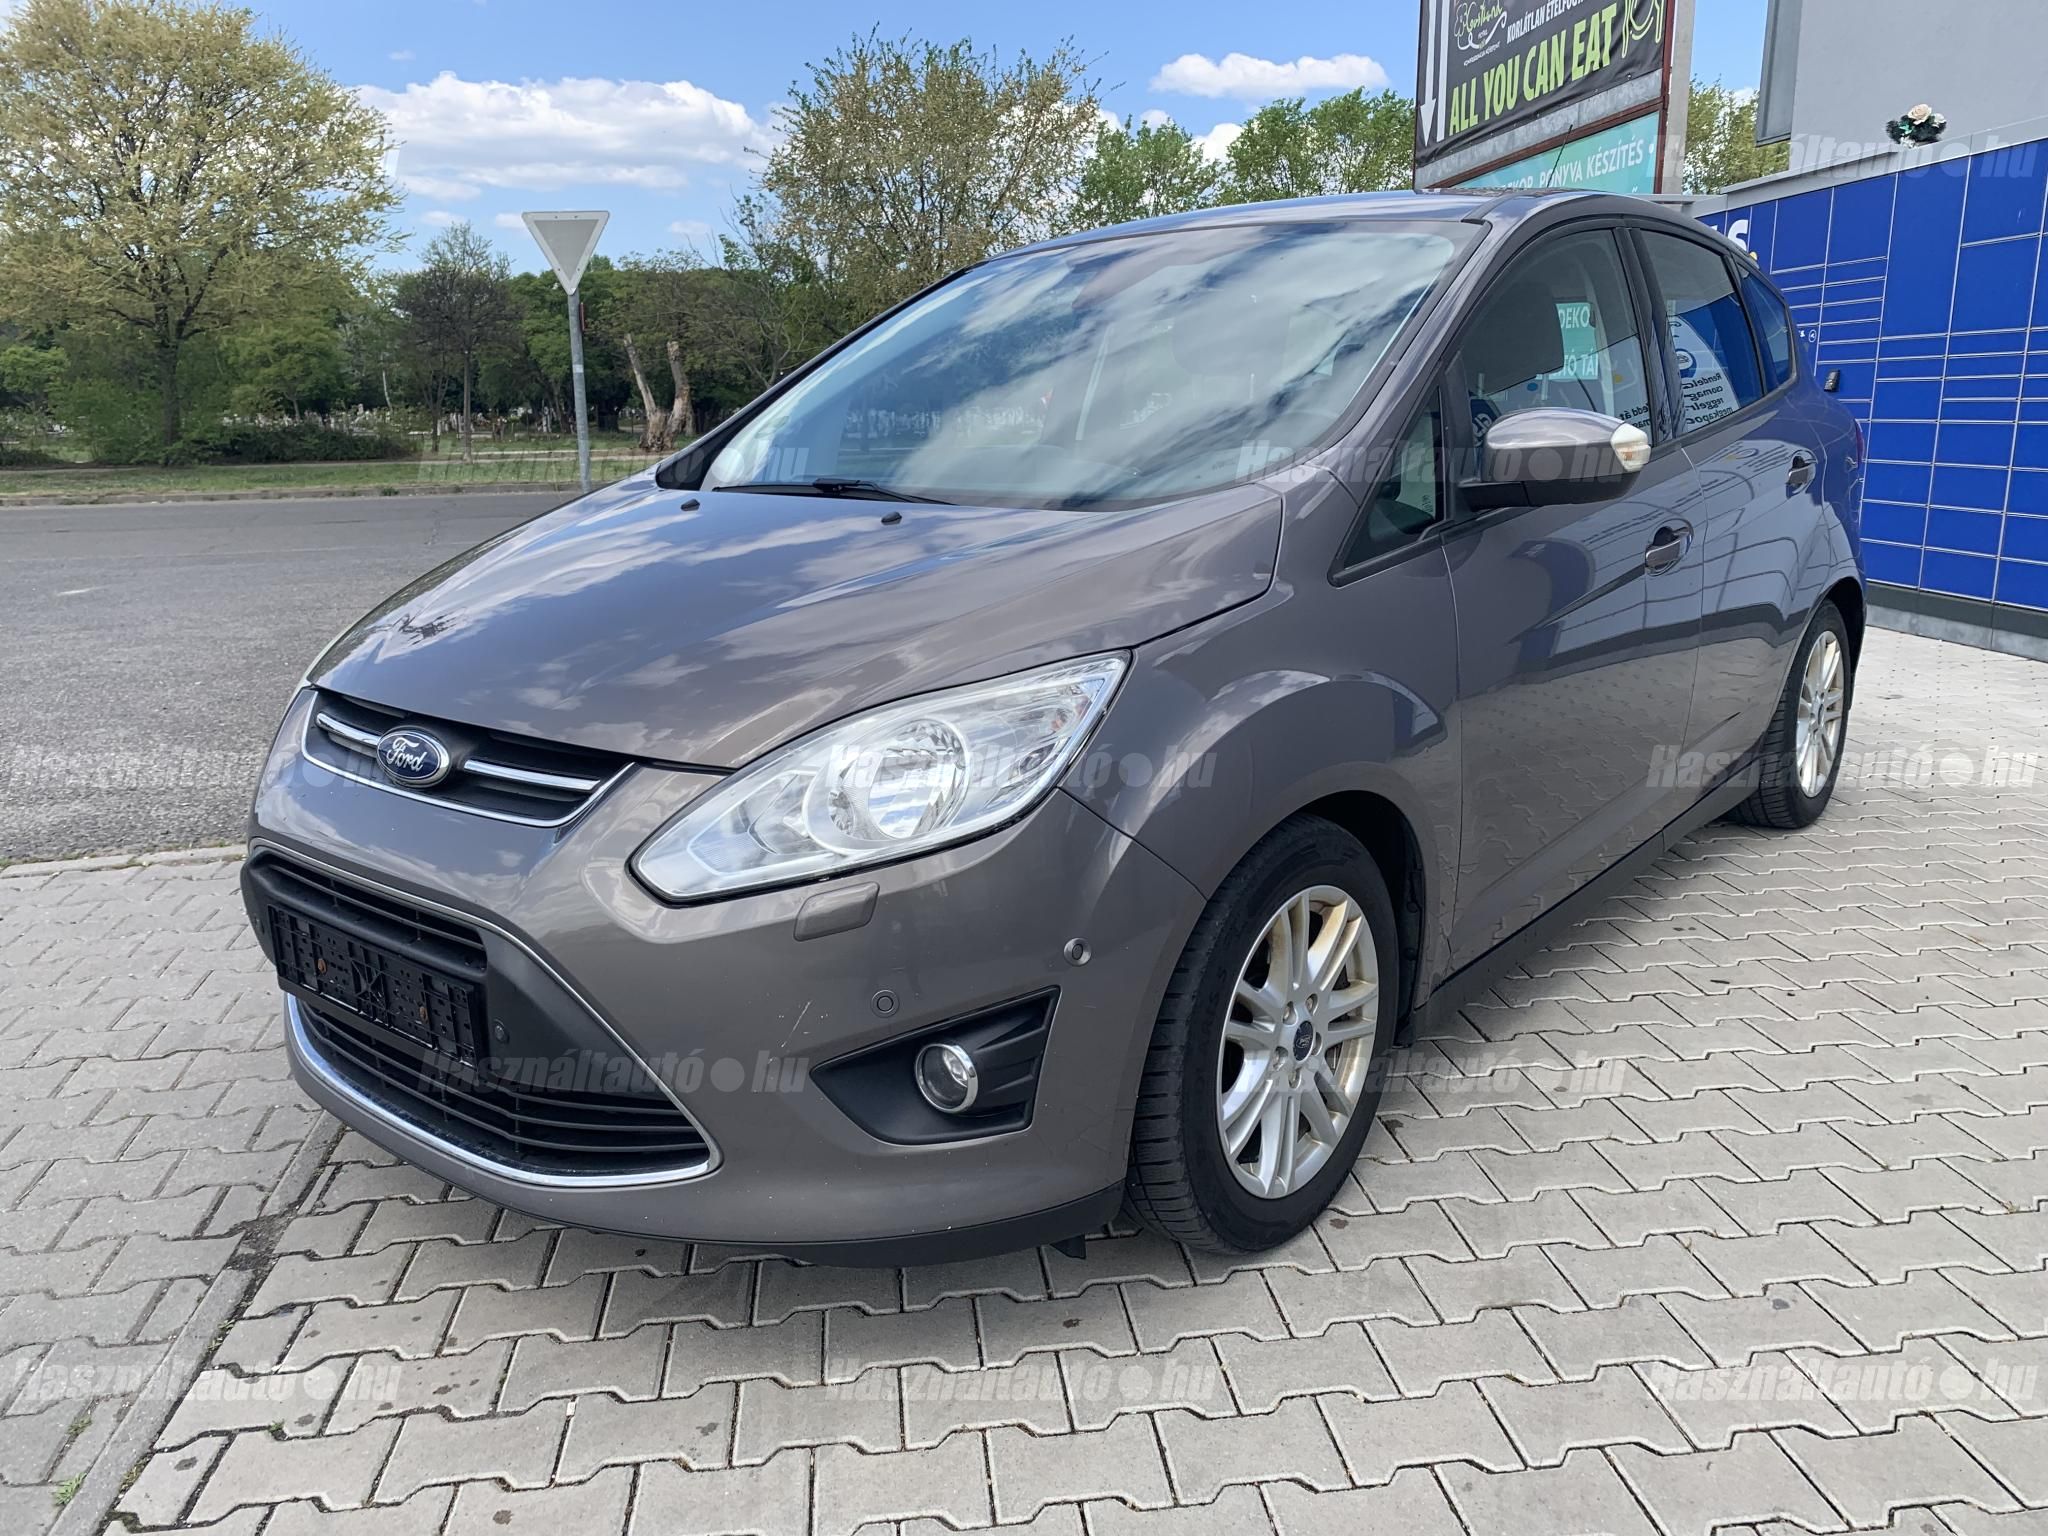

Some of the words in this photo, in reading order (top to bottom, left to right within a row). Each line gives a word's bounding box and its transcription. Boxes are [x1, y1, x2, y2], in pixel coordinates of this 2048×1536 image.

[1506, 5, 1546, 44] KORLÁTLAN
[1546, 0, 1585, 22] ÉTELFO
[1449, 86, 1479, 136] ALL
[1483, 55, 1520, 120] YOU
[1523, 30, 1567, 101] CAN
[1572, 3, 1617, 81] EAT
[1539, 160, 1583, 187] PONYVA
[1586, 135, 1644, 178] KÉSZÍTÉS
[386, 737, 428, 772] Ford
